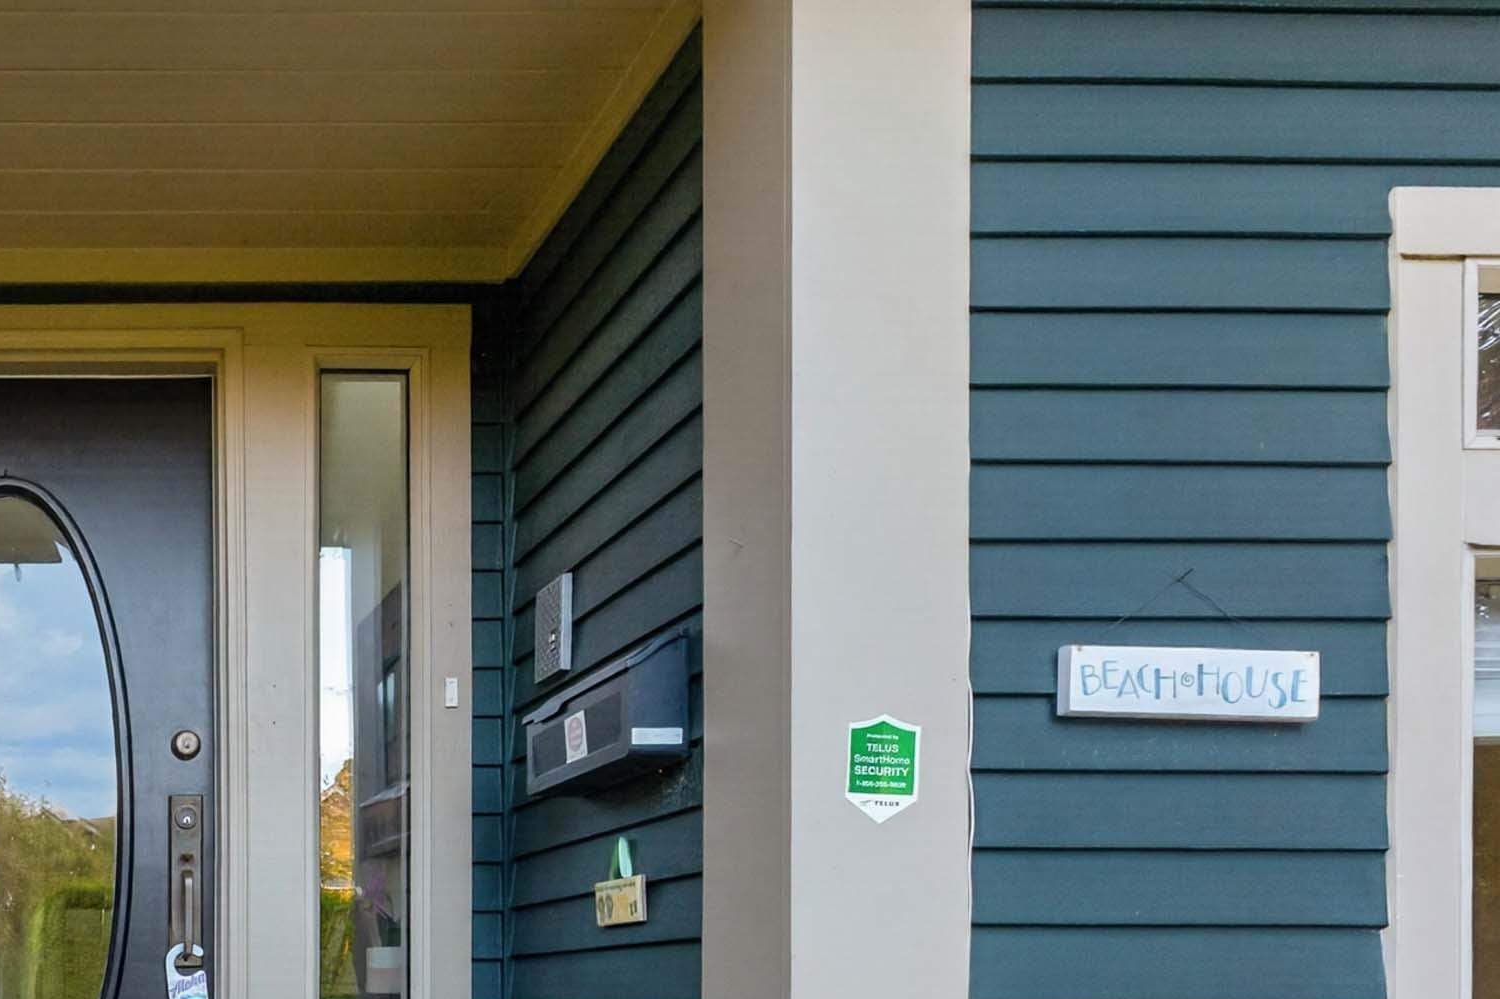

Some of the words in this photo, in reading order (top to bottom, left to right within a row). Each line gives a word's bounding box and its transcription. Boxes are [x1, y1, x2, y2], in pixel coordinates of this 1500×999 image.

[1080, 660, 1177, 700] BEACH
[1197, 664, 1309, 709] HOUSE
[866, 743, 900, 753] TELUS
[853, 754, 910, 765] SmartHome
[854, 765, 909, 777] SECURITY
